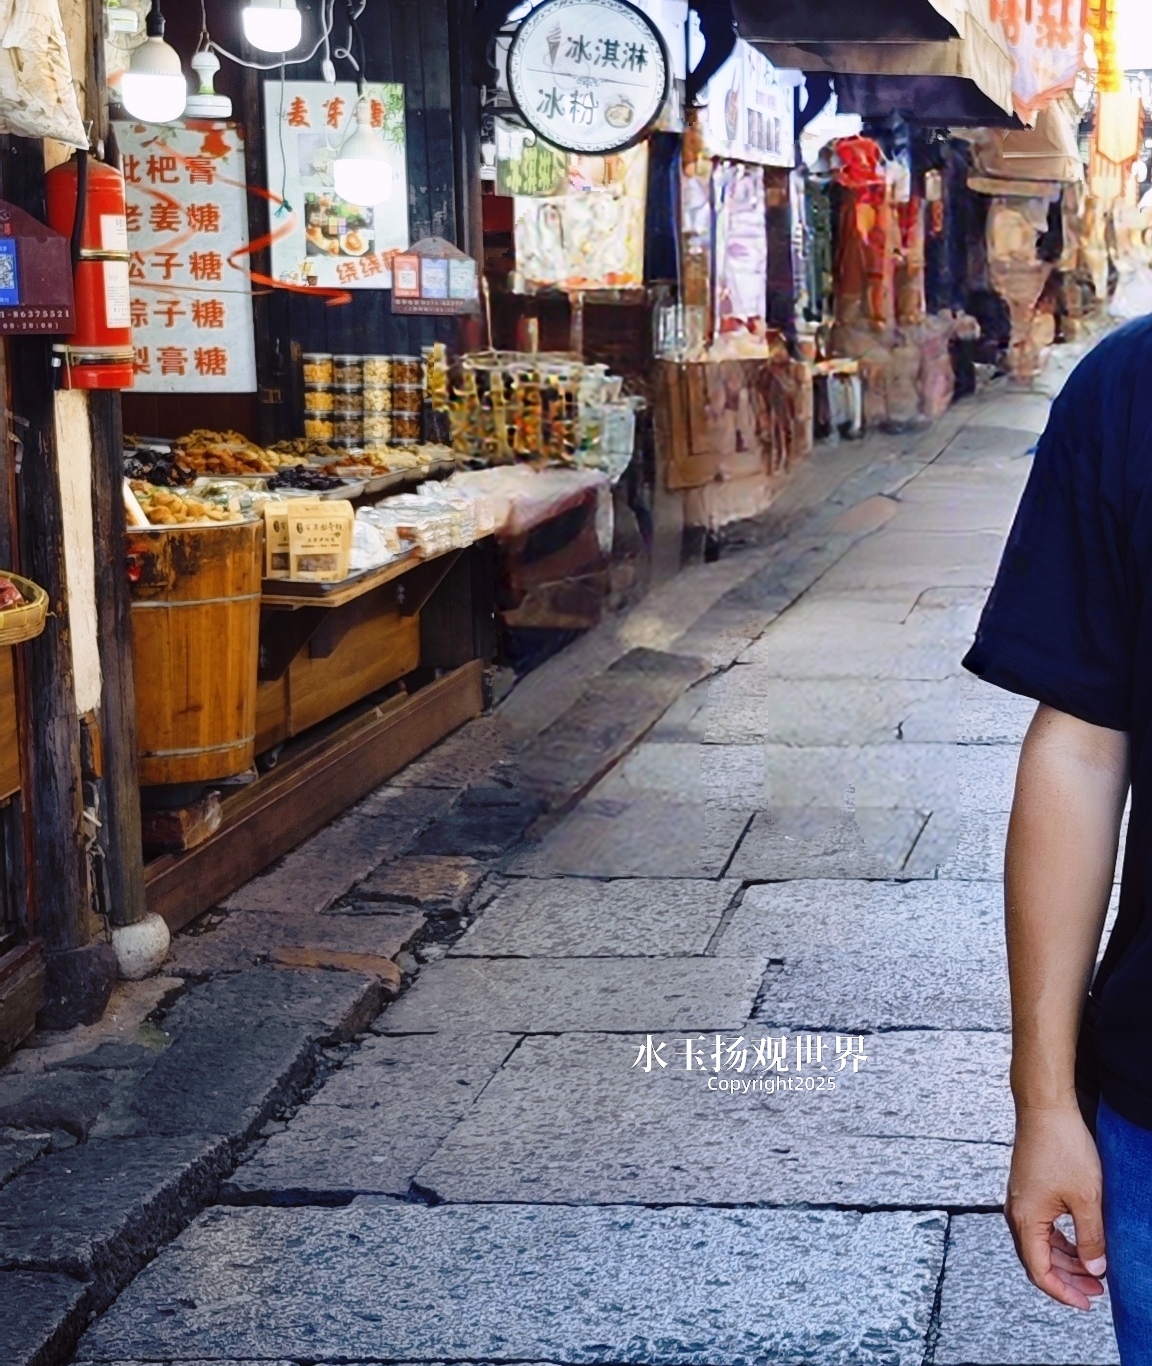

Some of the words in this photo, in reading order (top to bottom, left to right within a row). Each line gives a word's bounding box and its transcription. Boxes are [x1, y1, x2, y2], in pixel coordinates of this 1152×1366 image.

[564, 34, 649, 74] 冰淇淋
[536, 86, 599, 125] 冰粉
